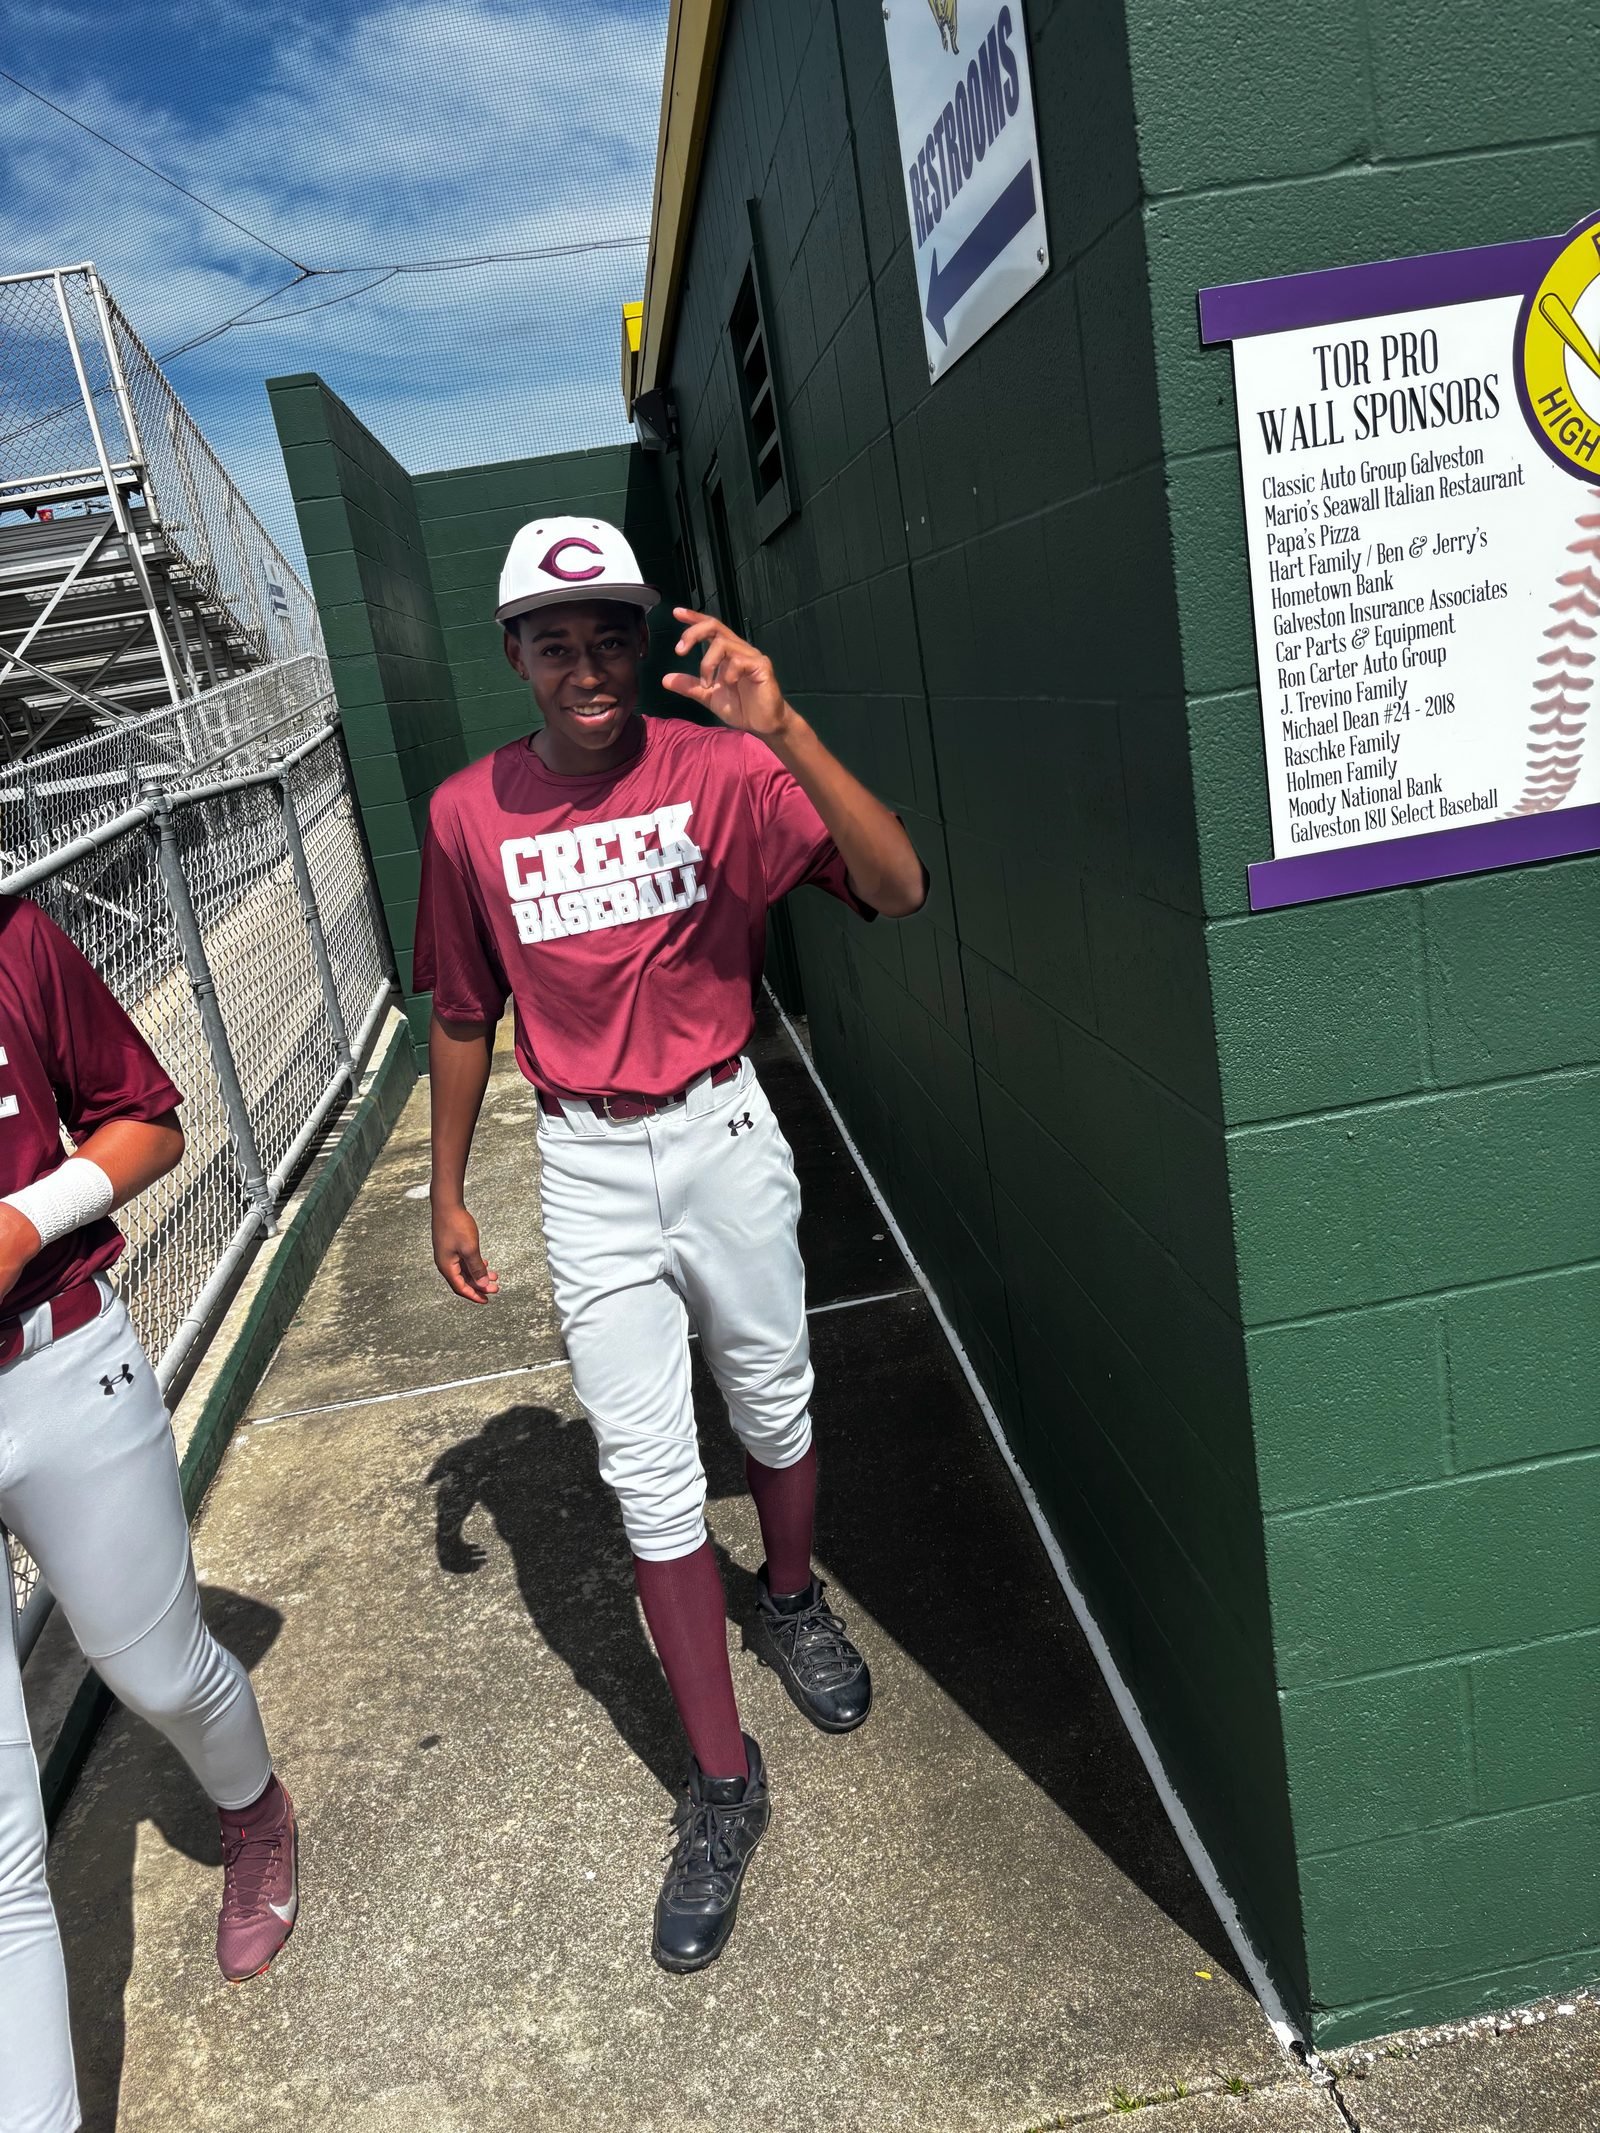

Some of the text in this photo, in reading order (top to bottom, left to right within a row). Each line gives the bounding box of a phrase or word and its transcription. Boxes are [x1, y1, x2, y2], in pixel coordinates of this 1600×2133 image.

[908, 4, 1020, 250] RESTROOMS
[1313, 329, 1438, 391] TOR PRO
[1257, 374, 1499, 454] WALL SPONSORS
[1538, 386, 1600, 462] HIGH
[1263, 446, 1483, 499] Classic Auto Group Galveston
[1265, 464, 1525, 527] Mario's Seawall Italian Restaurant
[538, 537, 606, 582] C
[1267, 525, 1360, 557] Papa's Pizza
[1269, 527, 1487, 582] Hart Family / Ben & Jerry's
[1272, 570, 1393, 609] Hometown Bank
[1274, 580, 1507, 635] Galveston Insurance Associates
[1276, 613, 1456, 662] Car Parts & Equipment
[1278, 645, 1446, 689] Ron Carter Auto Group
[1281, 676, 1407, 715] J. Trevino Family
[1283, 713, 1338, 742] Michael
[1343, 711, 1379, 731] Dean
[1384, 701, 1410, 724] #24
[1425, 693, 1455, 716] 2018
[1284, 730, 1400, 768] Raschke Family
[1287, 757, 1397, 793] Holmen Family
[1289, 774, 1442, 818] Moody National Bank
[1291, 789, 1497, 843] Galveston 18U Select Baseball
[500, 801, 703, 902] CREEK
[512, 865, 708, 944] BASEBALL
